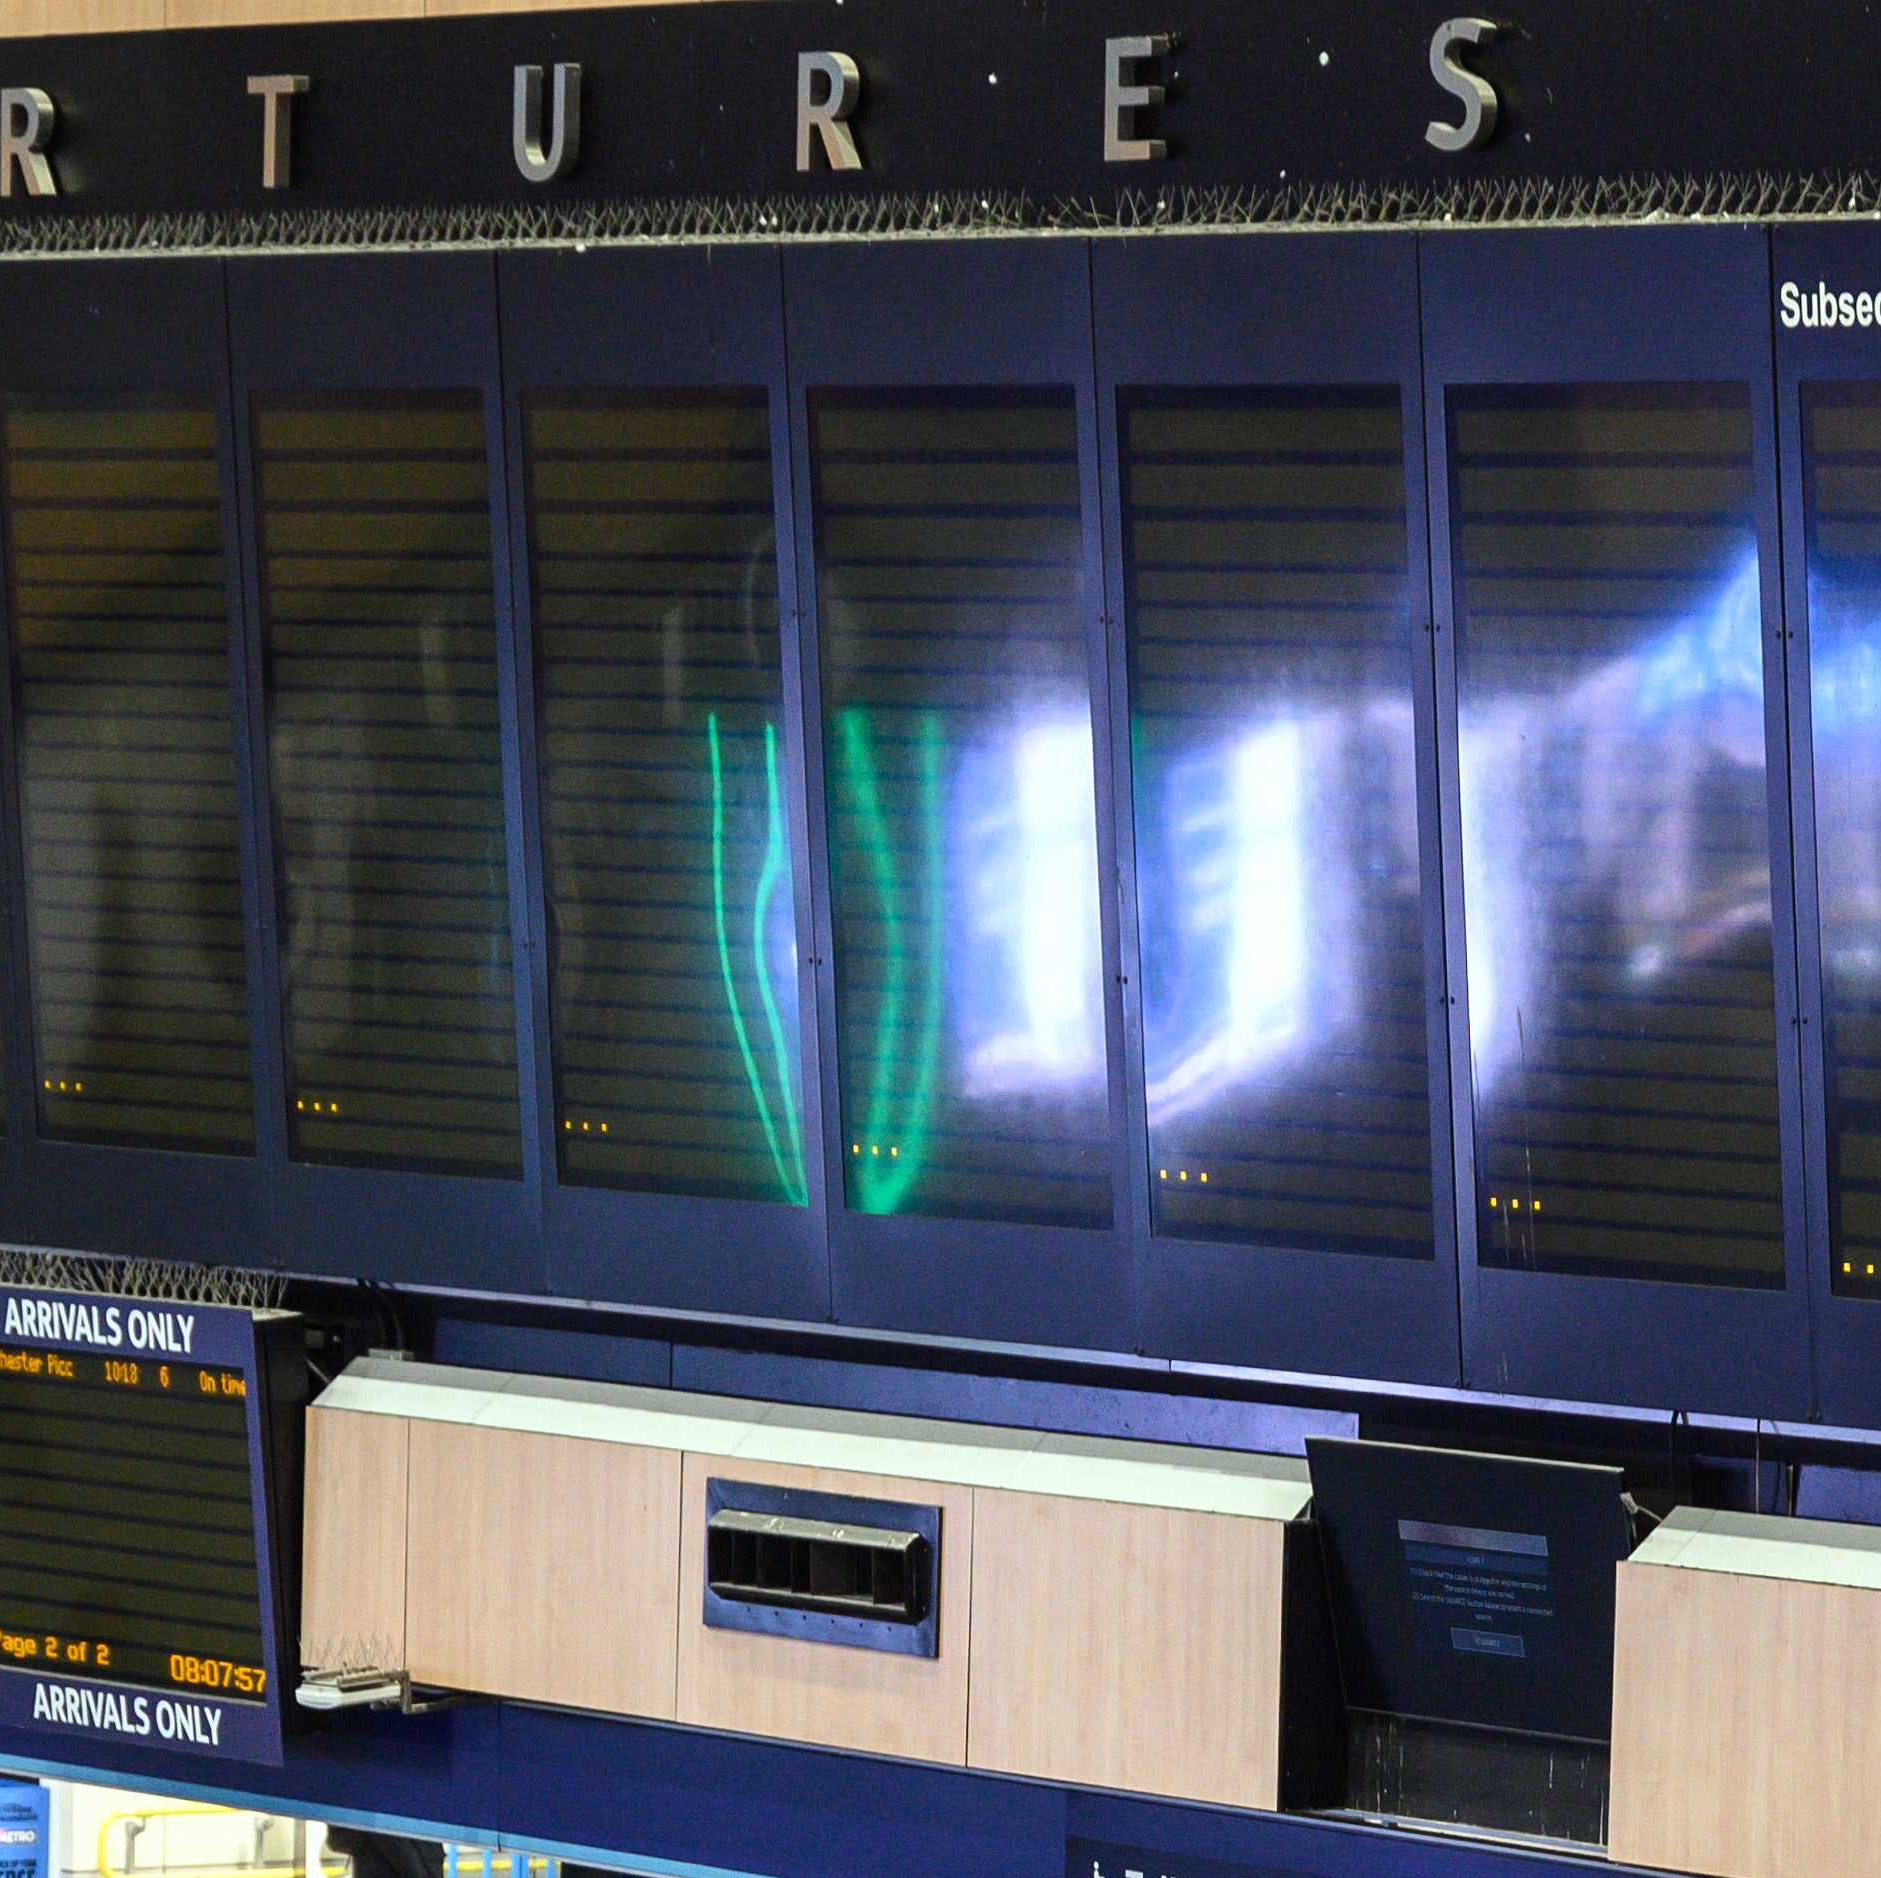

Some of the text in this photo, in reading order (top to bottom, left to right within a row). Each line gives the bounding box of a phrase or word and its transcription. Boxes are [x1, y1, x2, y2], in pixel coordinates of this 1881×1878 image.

[4, 1297, 195, 1353] ARRIVALS ONLY
[47, 1353, 73, 1377] Picc
[104, 1361, 139, 1385] 1018
[200, 1370, 216, 1392] On
[45, 1635, 58, 1659] 2
[67, 1641, 88, 1663] of
[96, 1644, 110, 1666] 2
[169, 1654, 266, 1693] 08:07:57
[33, 1682, 222, 1746] ARRIVALS ONLY
